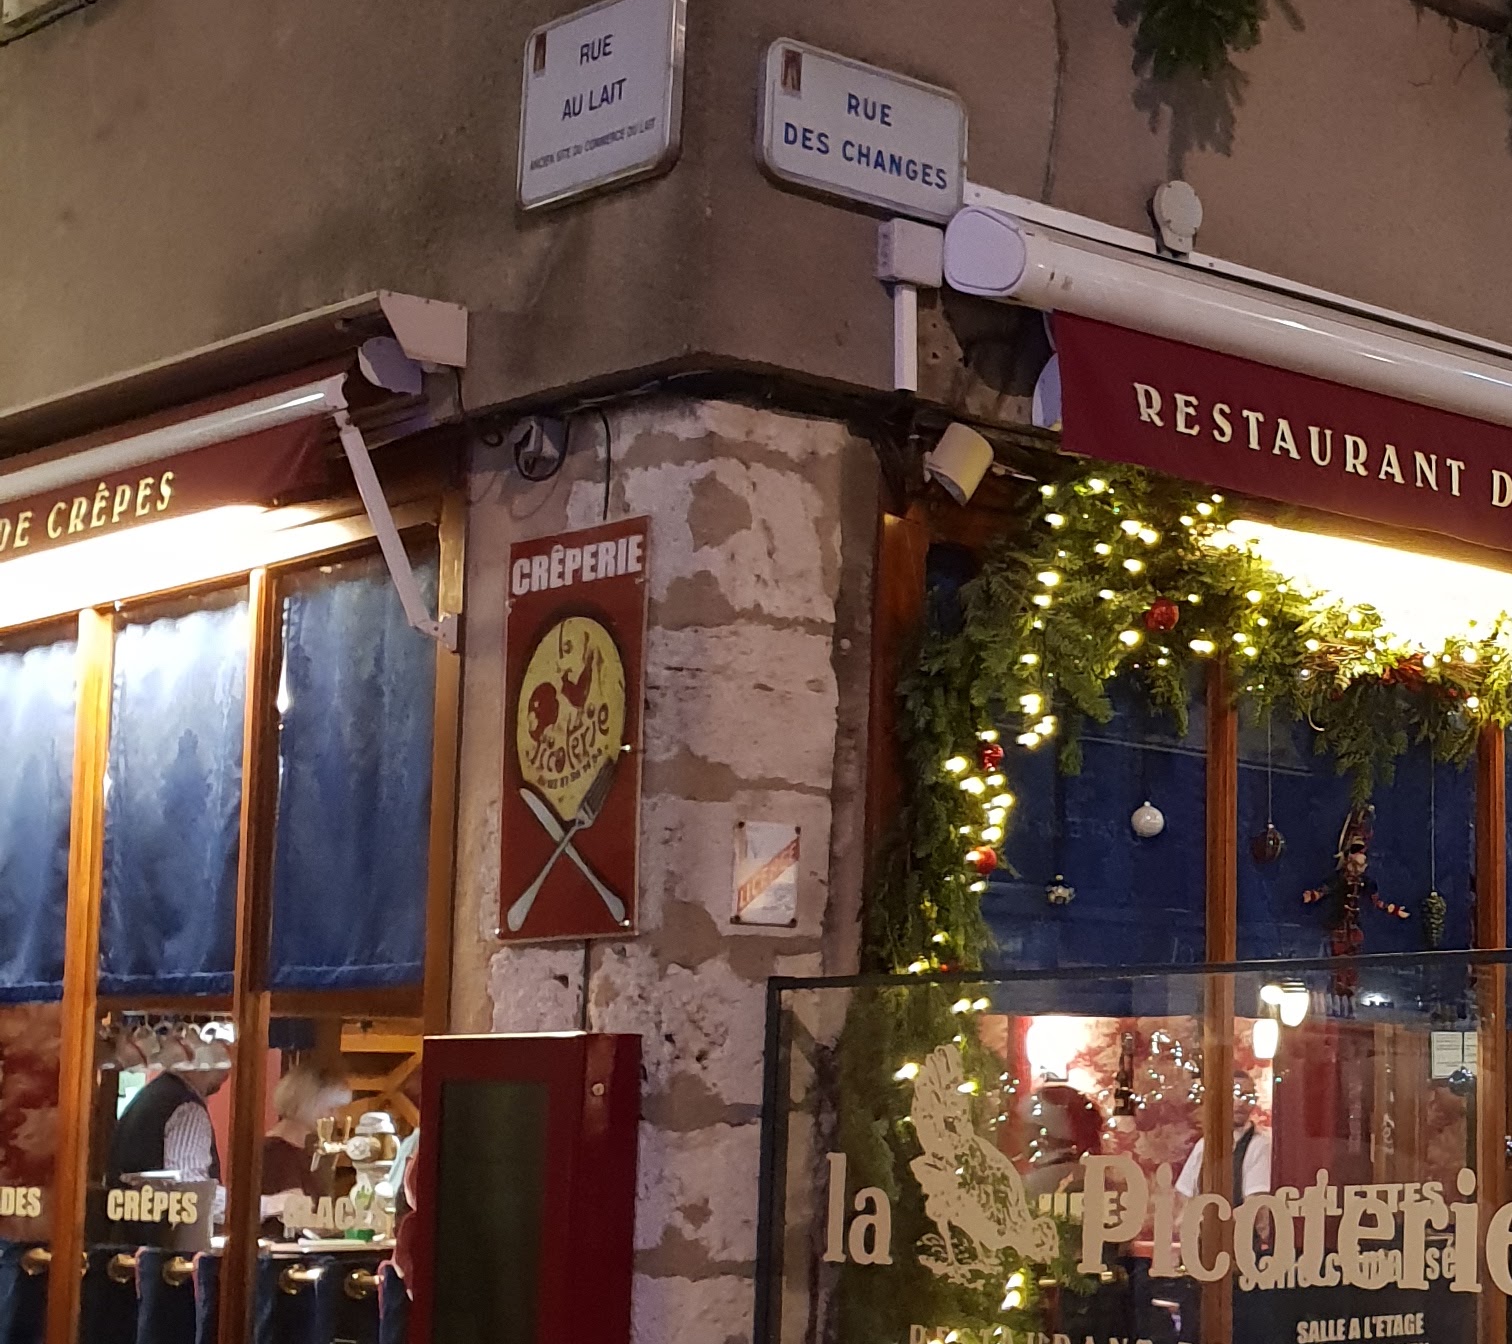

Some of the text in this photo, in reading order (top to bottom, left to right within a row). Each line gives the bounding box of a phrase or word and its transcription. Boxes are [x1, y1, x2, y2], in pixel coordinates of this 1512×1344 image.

[579, 34, 614, 65] RUE
[561, 78, 627, 121] AU LAIT
[847, 93, 893, 127] RUE
[784, 122, 948, 190] DES CHANGES
[1132, 382, 1466, 497] RESTAURANT
[0, 471, 175, 553] DE CRÊPES
[512, 534, 644, 596] CRÊPERIE
[106, 1184, 198, 1224] CRÊPES
[822, 1151, 894, 1266] la
[1275, 1181, 1444, 1218] GLETTES
[1296, 1312, 1425, 1344] SALLE A L'ETAGE
